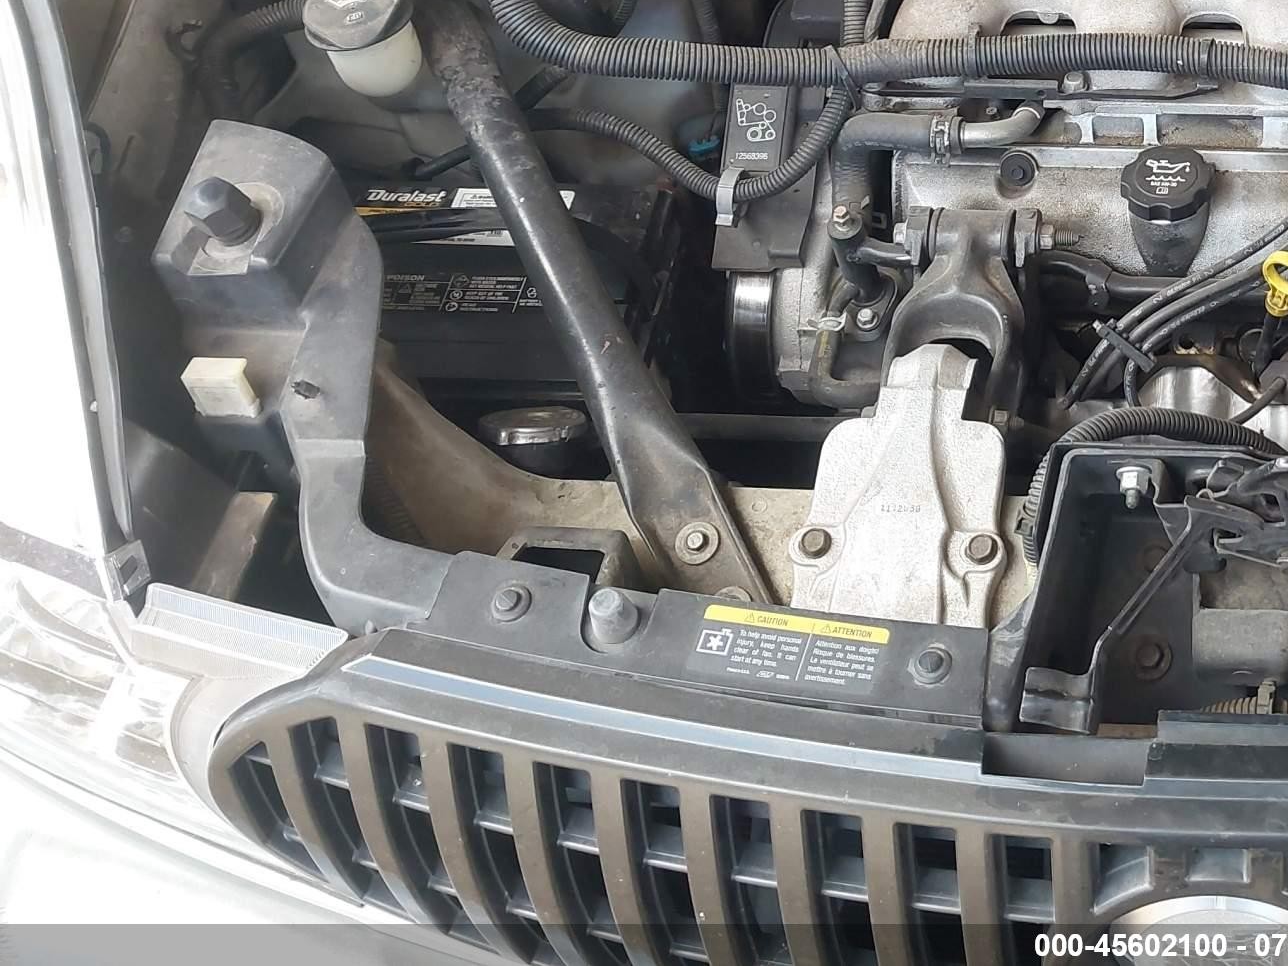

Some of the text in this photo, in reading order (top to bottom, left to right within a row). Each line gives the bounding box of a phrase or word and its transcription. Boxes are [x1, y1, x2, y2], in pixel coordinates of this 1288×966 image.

[367, 189, 448, 202] Duralast
[757, 615, 790, 627] CAUTION
[832, 626, 873, 639] ATTENTION
